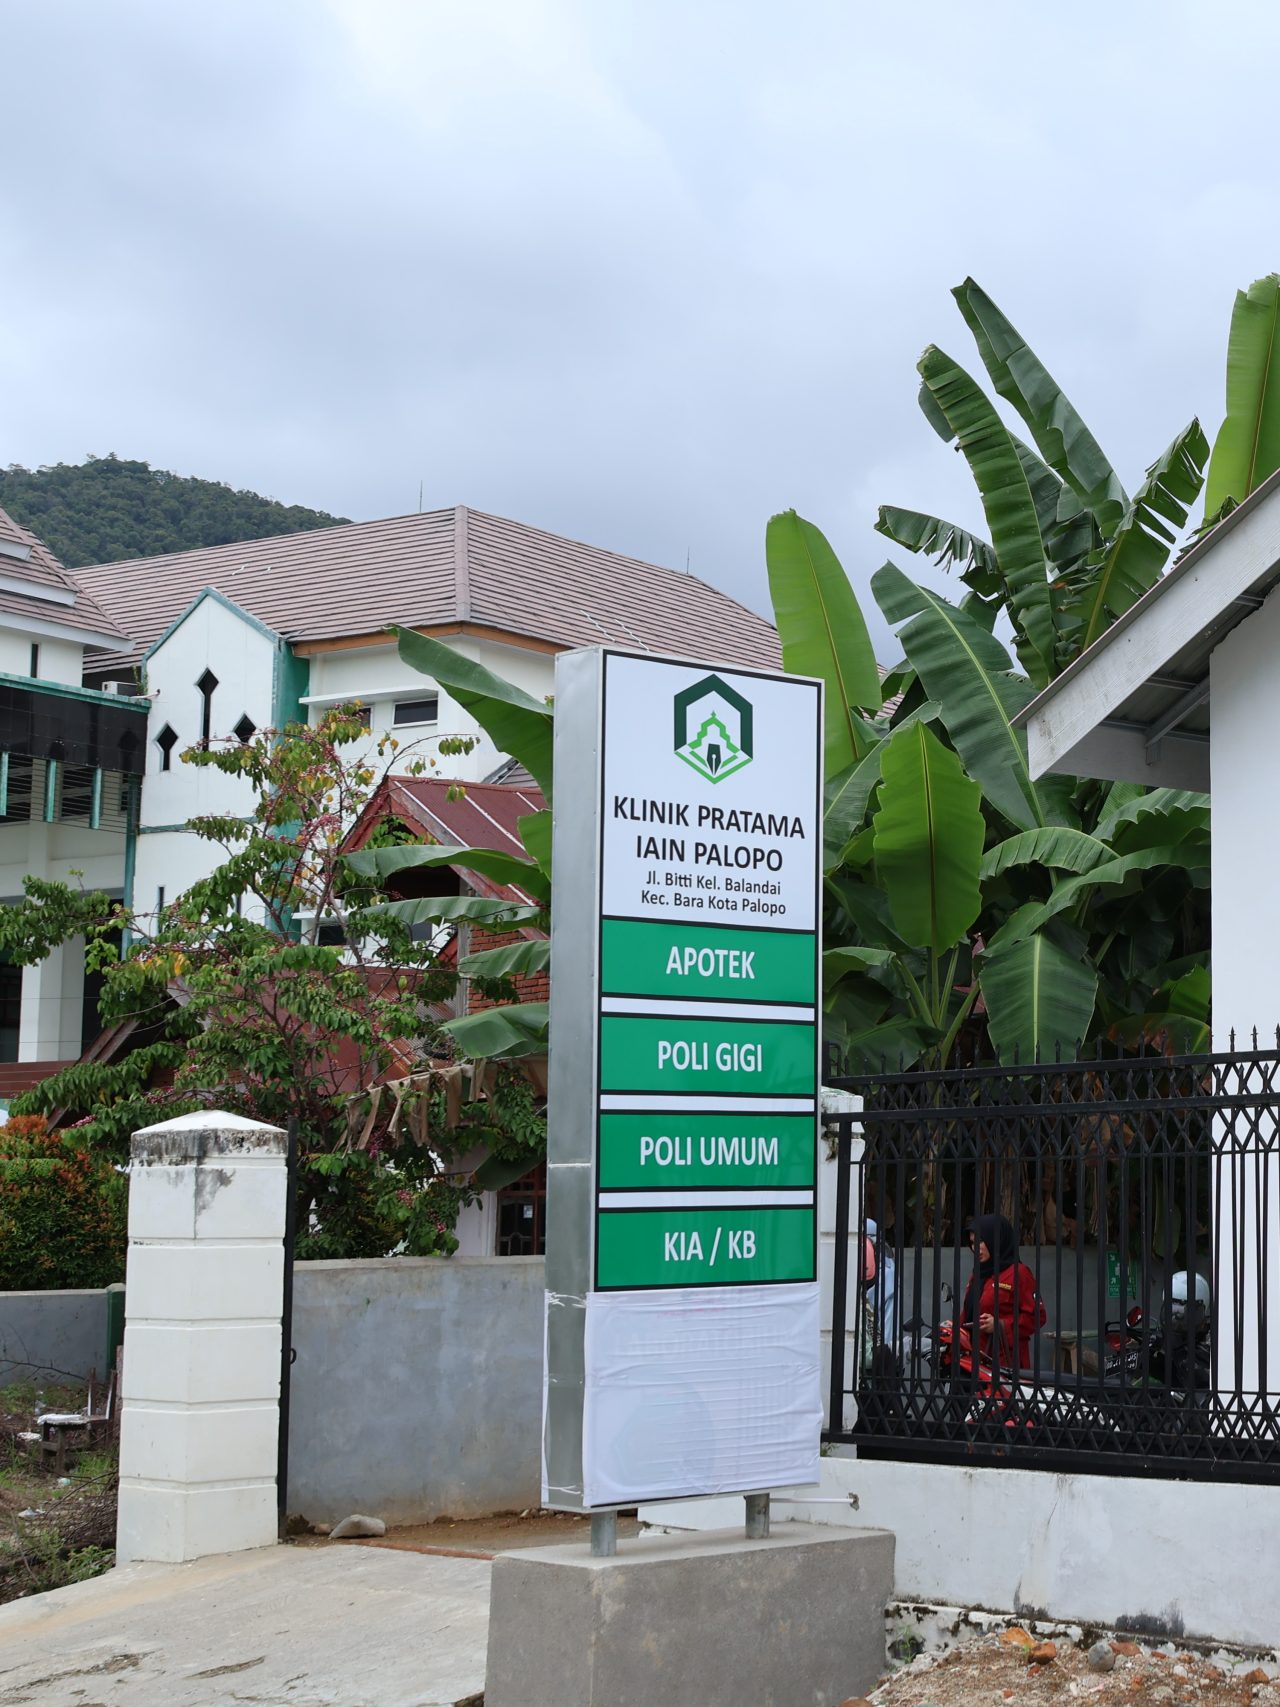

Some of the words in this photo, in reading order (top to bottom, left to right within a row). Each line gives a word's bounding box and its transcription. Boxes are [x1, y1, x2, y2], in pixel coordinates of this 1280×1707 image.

[614, 795, 689, 827] KLINIK
[698, 804, 805, 839] PRATAMA
[636, 835, 685, 862] IAIN
[694, 842, 783, 872] PALOPO
[646, 870, 660, 886] Jl.
[665, 872, 692, 888] Bitti
[696, 875, 721, 891] Kel.
[725, 877, 781, 895] Balandai
[641, 889, 670, 906] Kec.
[673, 893, 704, 908] Bara
[708, 895, 738, 911] Kota
[742, 898, 786, 917] Palopo
[666, 946, 756, 979] APOTEK
[658, 1040, 708, 1071] POLI
[715, 1042, 763, 1073] GIGI
[639, 1136, 692, 1166] POLI
[699, 1136, 779, 1166] UMUM
[664, 1231, 704, 1262] KIA
[709, 1227, 722, 1266] /
[728, 1229, 756, 1260] KB
